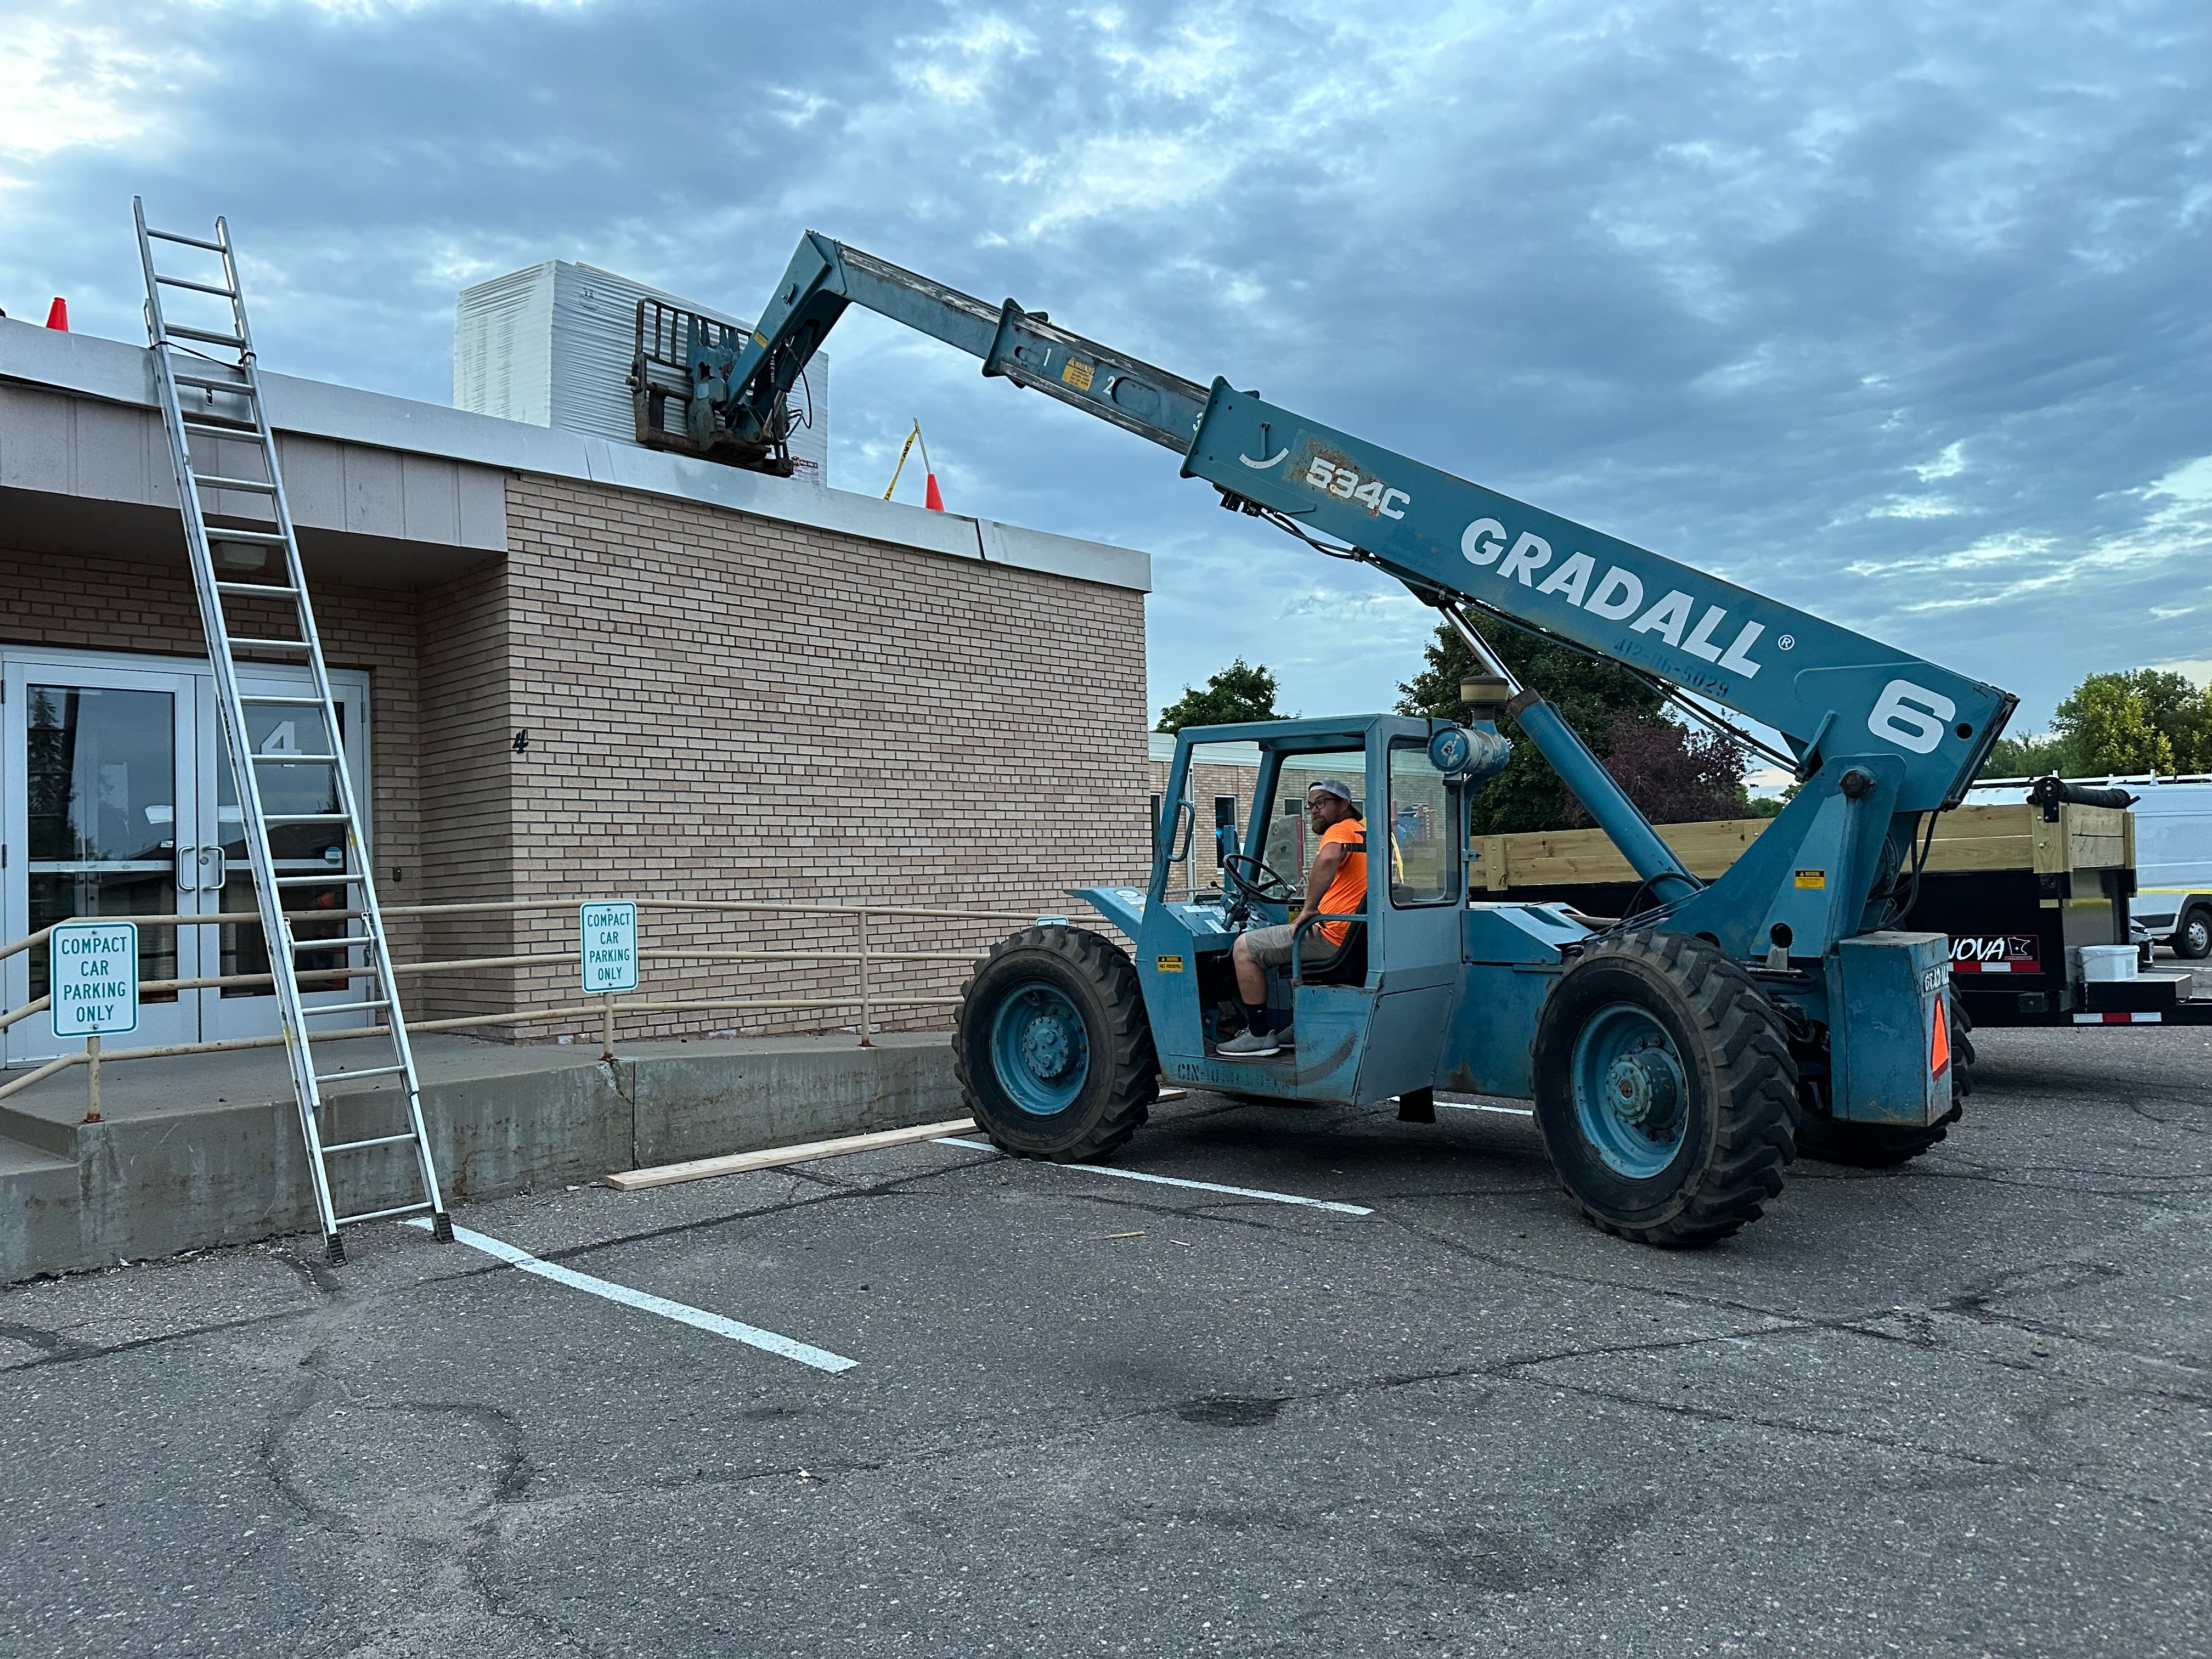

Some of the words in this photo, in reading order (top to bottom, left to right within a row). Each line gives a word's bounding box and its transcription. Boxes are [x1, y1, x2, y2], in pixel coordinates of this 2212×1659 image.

[1043, 348, 1052, 366] 1
[1103, 375, 1115, 395] 2
[1306, 456, 1410, 520] 534C
[1462, 518, 1765, 679] GRADALL
[1868, 679, 1956, 754] 6
[261, 721, 302, 767] 4
[512, 729, 528, 754] 4
[588, 913, 630, 927] COMPACT
[61, 937, 127, 955] COMPACT
[600, 932, 618, 944] CAR
[590, 949, 629, 963] PARKING
[81, 960, 109, 976] CAR
[598, 967, 622, 980] ONLY
[64, 981, 126, 1000] PARKING
[76, 1005, 114, 1022] ONLY
